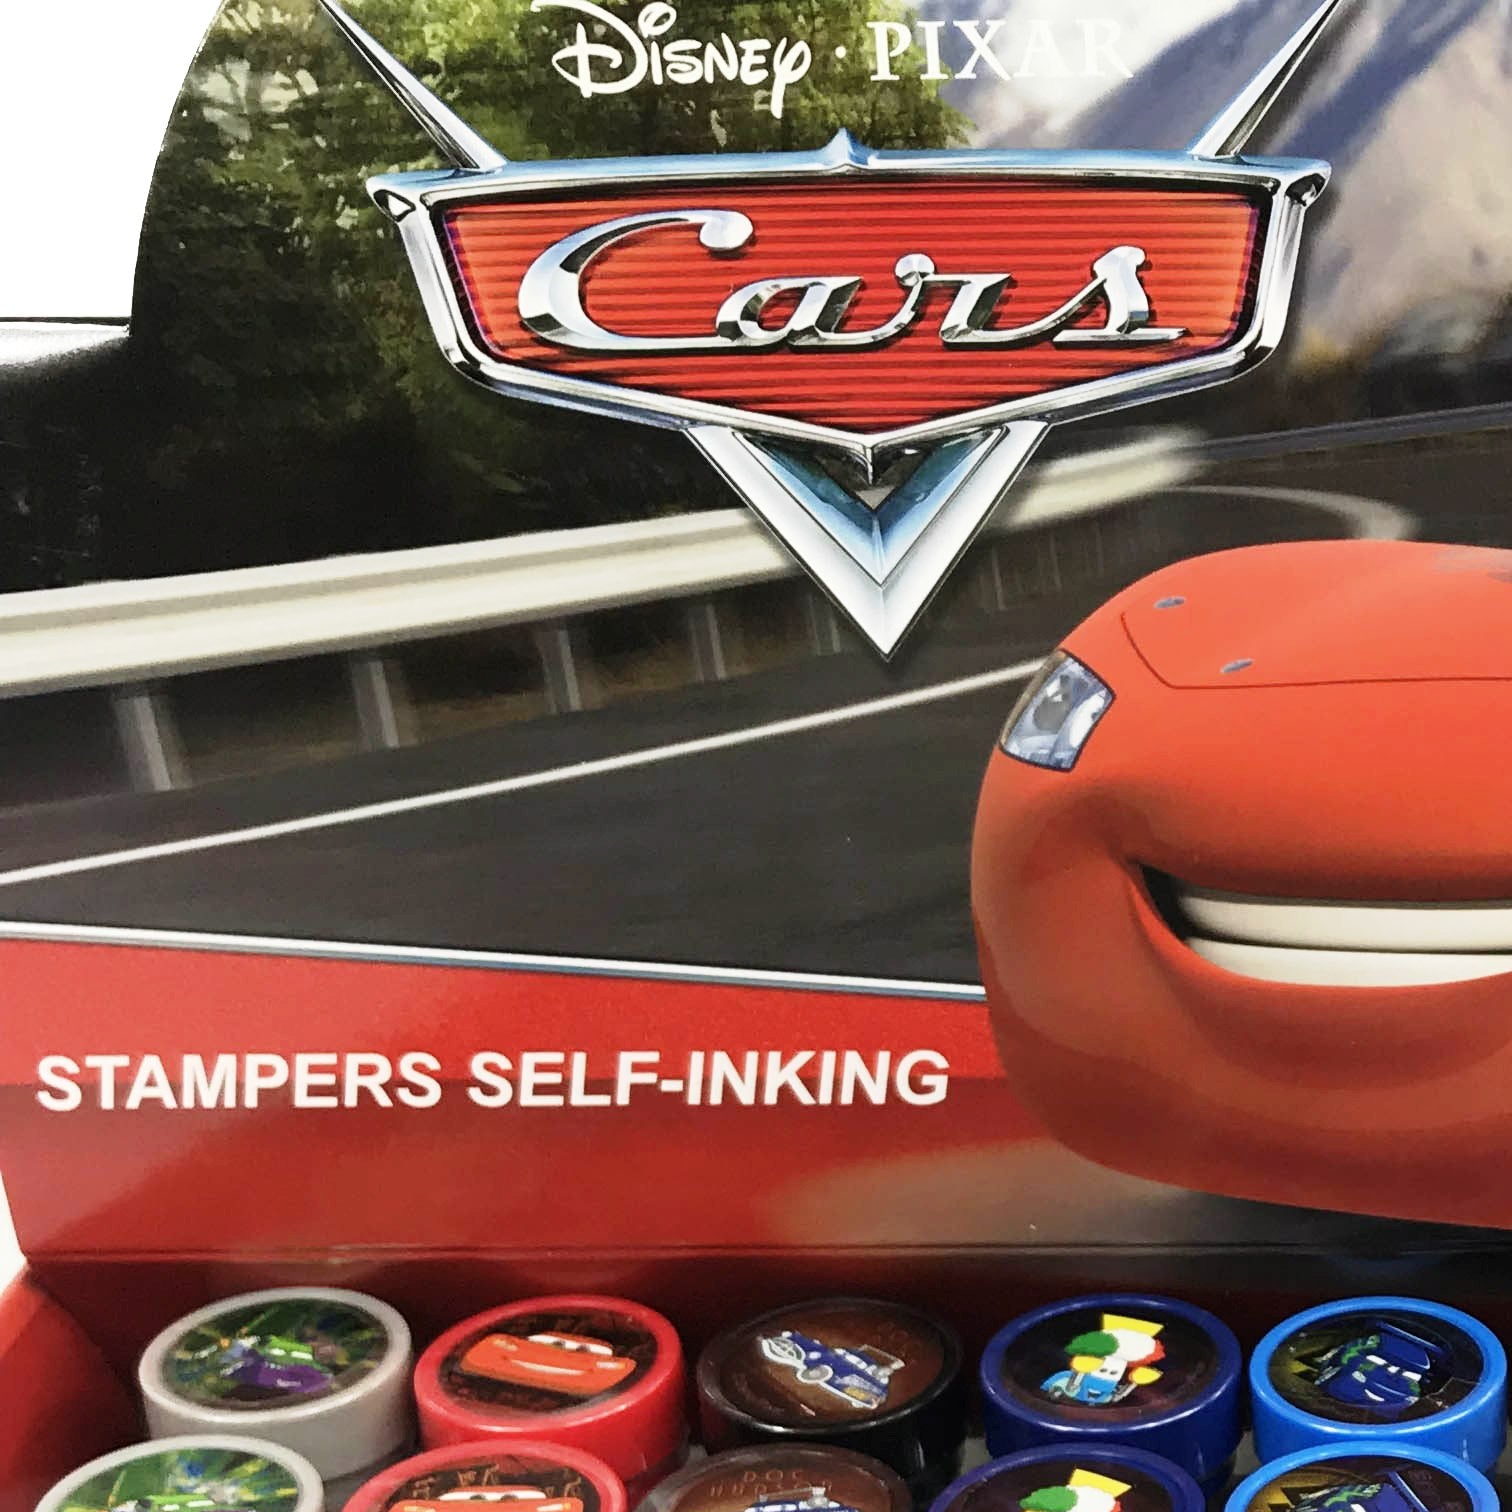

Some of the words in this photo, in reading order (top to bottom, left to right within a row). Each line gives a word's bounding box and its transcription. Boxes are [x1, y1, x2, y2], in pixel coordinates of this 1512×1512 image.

[530, 0, 811, 117] Disney
[869, 20, 1134, 83] PIXAR
[517, 209, 1188, 353] Cars
[36, 1053, 443, 1110] STAMPERS
[467, 1049, 951, 1107] SELF-INKING
